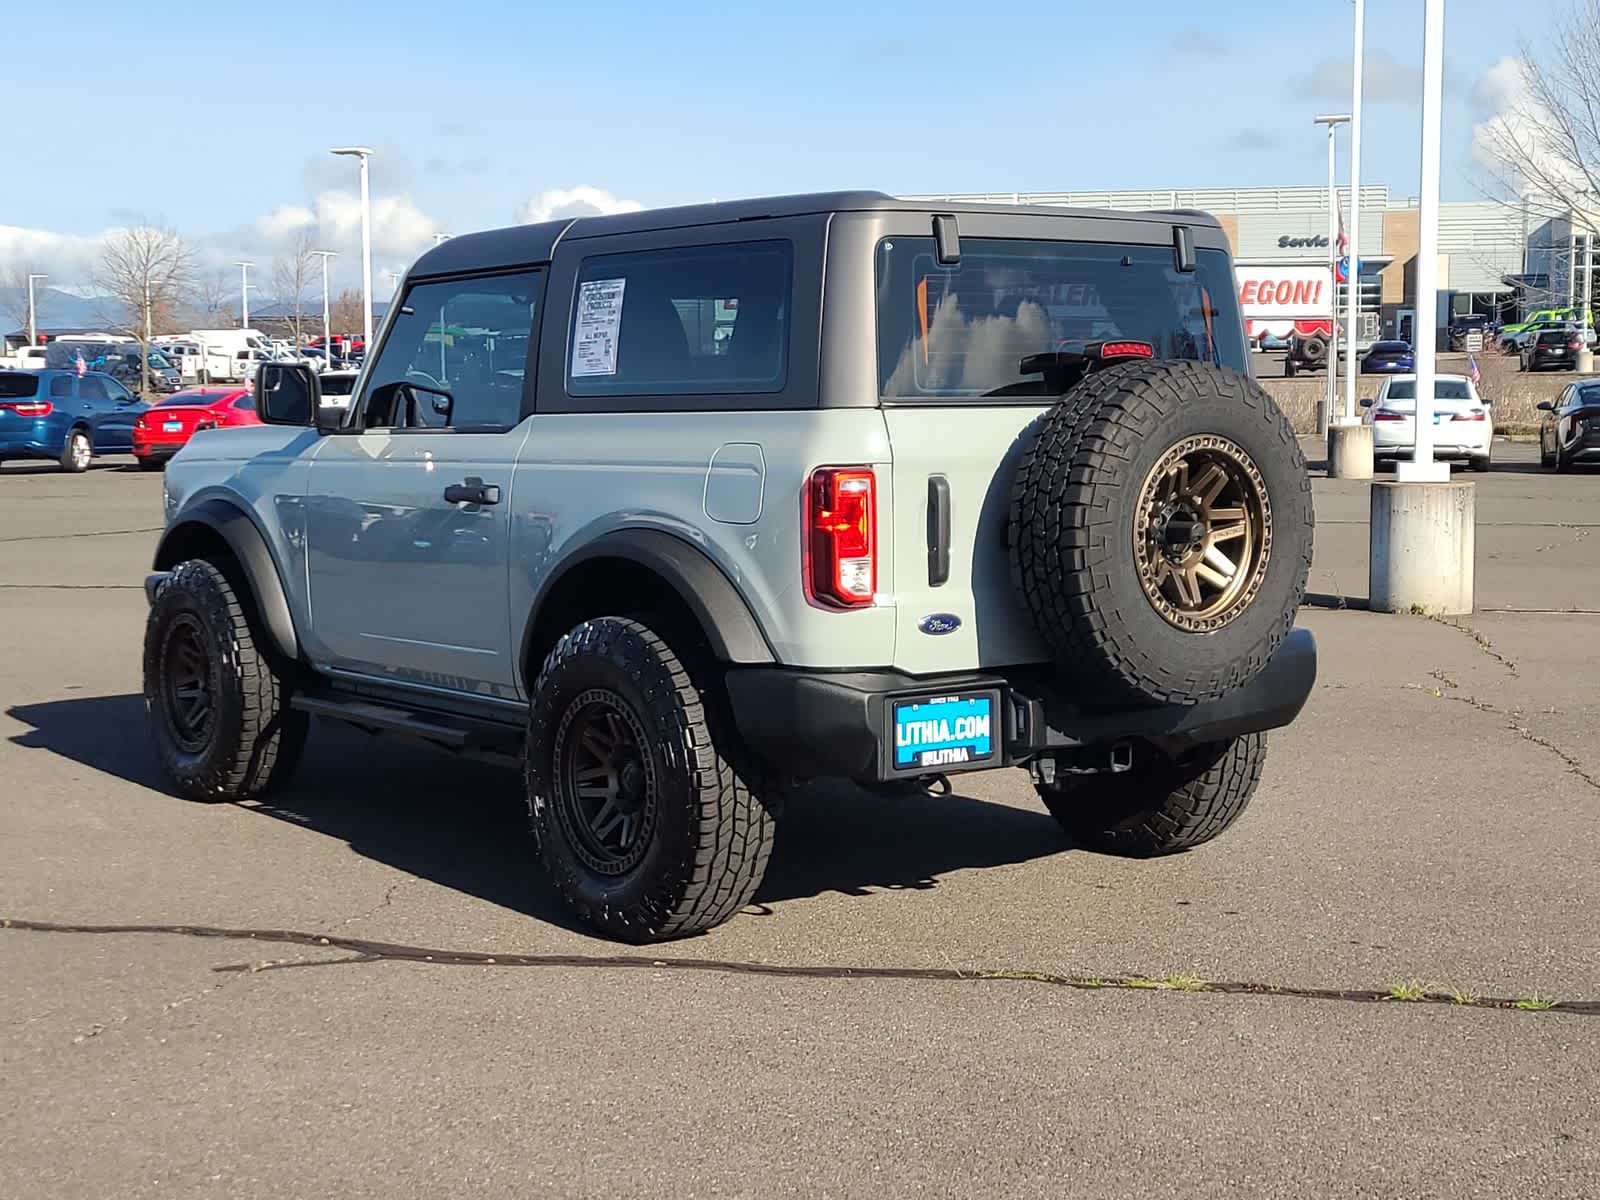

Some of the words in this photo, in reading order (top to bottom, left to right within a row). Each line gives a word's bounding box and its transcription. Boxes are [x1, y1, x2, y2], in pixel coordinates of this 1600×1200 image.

[1278, 235, 1330, 248] Servic
[1237, 279, 1323, 305] EGON!
[897, 714, 990, 747] LITHIA.COM
[933, 747, 969, 765] LITHIA
